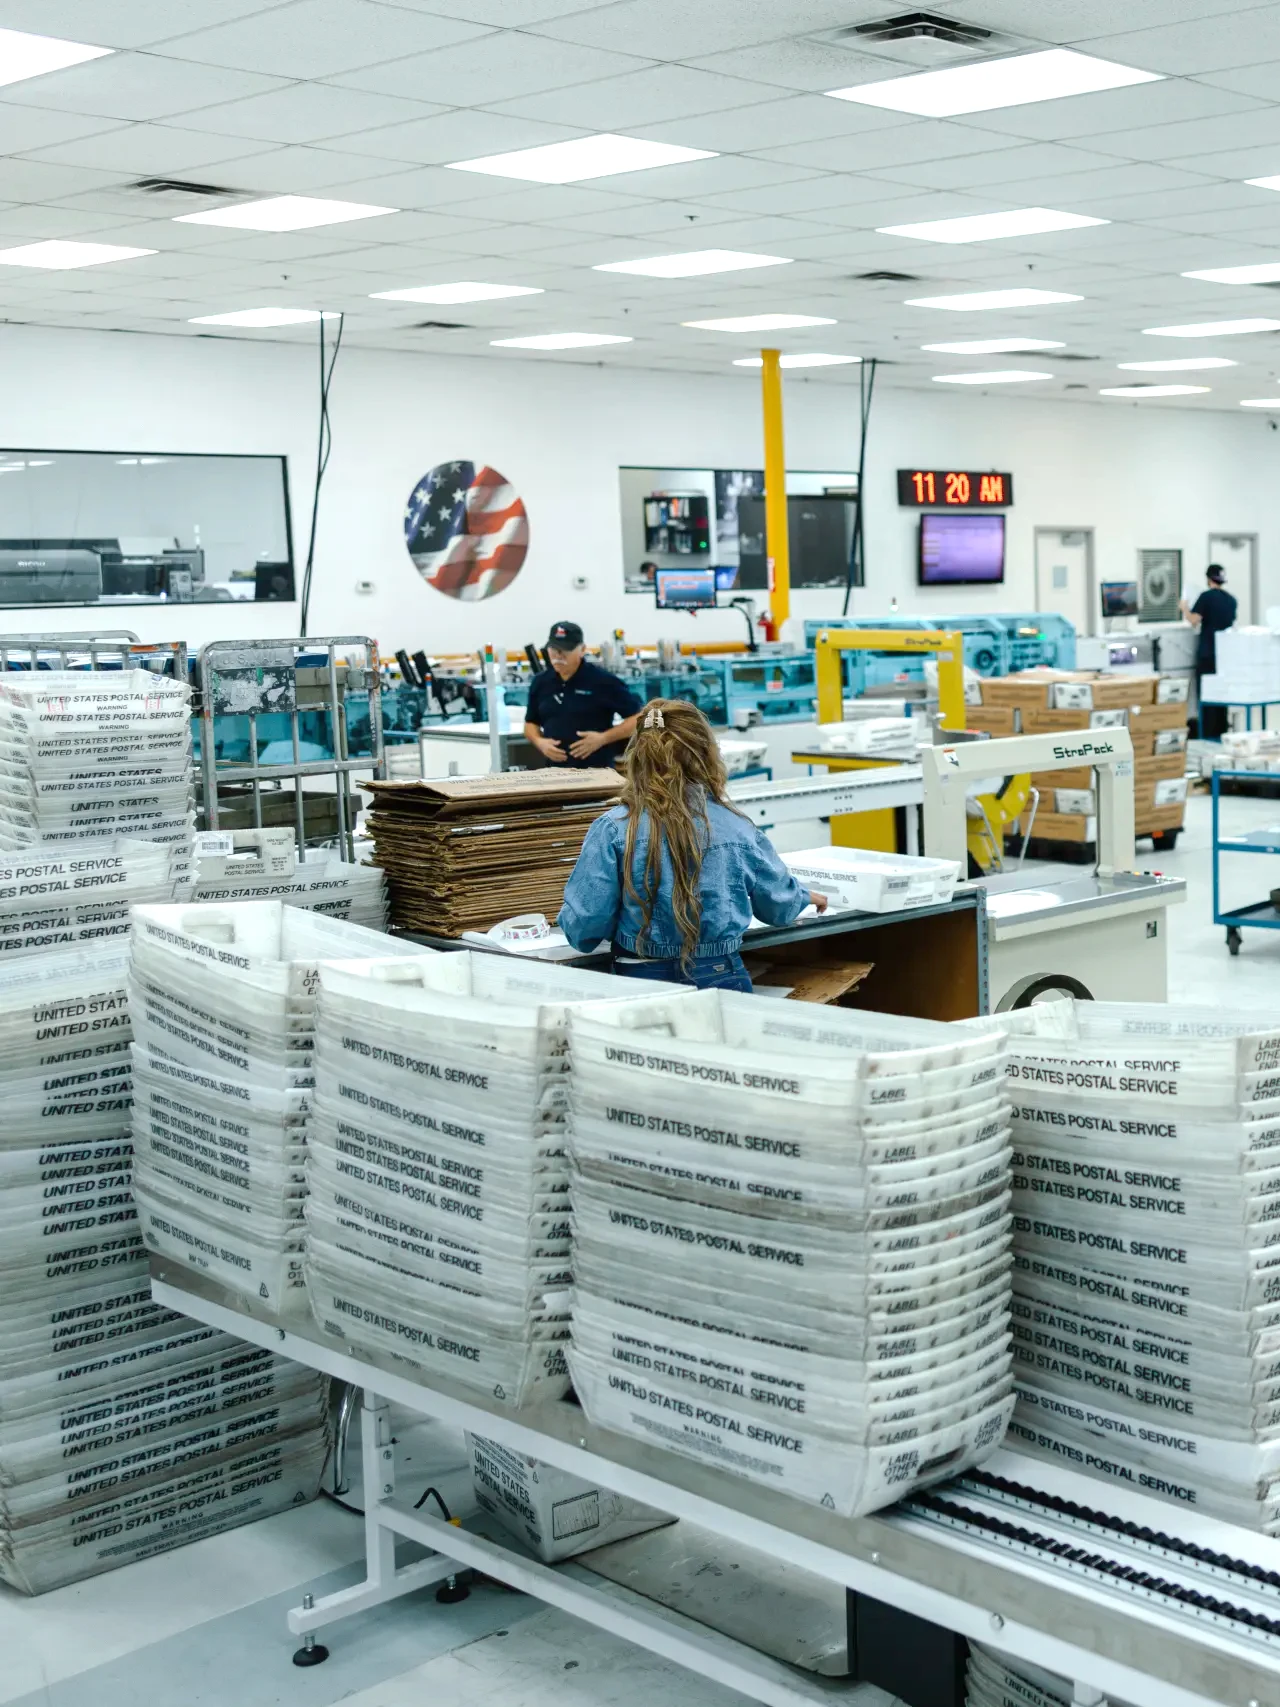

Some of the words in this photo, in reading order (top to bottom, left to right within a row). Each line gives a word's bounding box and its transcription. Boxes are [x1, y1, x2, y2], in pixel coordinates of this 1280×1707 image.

[912, 472, 936, 503] 11
[945, 474, 970, 503] 20
[980, 476, 1003, 502] AM
[73, 695, 109, 703] STATES
[111, 693, 144, 701] POSTAL
[148, 691, 183, 699] SERVICE
[40, 714, 73, 722] UNITED
[76, 713, 110, 721] STATES
[113, 712, 146, 720] POSTAL
[150, 710, 184, 719] SERVICE
[1053, 742, 1113, 758] StraPack
[41, 784, 75, 792] UNITED
[77, 782, 111, 791] STATES
[114, 779, 147, 788] POSTAL
[150, 775, 185, 785] SERVICE
[42, 832, 76, 841] UNITED
[79, 829, 113, 838] STATES
[116, 825, 149, 834] POSTAL
[152, 819, 187, 828] SERVICE
[16, 865, 65, 879] POSTAL
[70, 858, 123, 872] SERVICE
[20, 880, 69, 896] POSTAL
[74, 872, 127, 888] SERVICE
[231, 887, 269, 897] STATES
[270, 883, 306, 894] POSTAL
[310, 880, 349, 891] SERVICE
[313, 899, 353, 912] SERVICE
[26, 933, 76, 947] POSTAL
[79, 923, 132, 940] SERVICE
[145, 924, 167, 940] UNITED
[167, 932, 191, 950] STATES
[191, 942, 217, 960] POSTAL
[218, 949, 250, 969] SERVICE
[34, 1004, 85, 1023] UNITED
[145, 1010, 167, 1030] UNITED
[167, 1023, 190, 1043] STATES
[190, 1035, 216, 1056] POSTAL
[218, 1047, 249, 1070] SERVICE
[342, 1036, 371, 1056] UNITED
[372, 1047, 405, 1068] STATES
[406, 1058, 442, 1079] POSTAL
[445, 1068, 488, 1090] SERVICE
[604, 1047, 644, 1067] UNITED
[647, 1055, 689, 1077] STATES
[692, 1065, 740, 1085] POSTAL
[743, 1073, 800, 1094] SERVICE
[972, 1068, 996, 1082] LABEL
[1023, 1066, 1064, 1085] STATES
[1067, 1073, 1116, 1090] POSTAL
[1120, 1078, 1178, 1095] SERVICE
[870, 1088, 906, 1100] LABEL
[339, 1083, 368, 1105] UNITED
[369, 1096, 401, 1118] STATES
[403, 1109, 439, 1132] POSTAL
[442, 1122, 486, 1146] SERVICE
[1023, 1107, 1066, 1125] STATES
[1068, 1114, 1117, 1132] POSTAL
[1120, 1121, 1177, 1138] SERVICE
[151, 1108, 170, 1125] UNITED
[170, 1115, 193, 1134] STATES
[193, 1125, 219, 1145] POSTAL
[219, 1134, 249, 1155] SERVICE
[606, 1107, 645, 1128] UNITED
[648, 1116, 692, 1137] STATES
[694, 1125, 742, 1148] POSTAL
[744, 1136, 801, 1158] SERVICE
[39, 1149, 91, 1165] UNITED
[885, 1145, 916, 1159] LABEL
[336, 1161, 365, 1180] UNITED
[367, 1172, 400, 1193] STATES
[402, 1184, 438, 1207] POSTAL
[440, 1196, 484, 1221] SERVICE
[887, 1192, 918, 1206] LABEL
[43, 1216, 95, 1236] UNITED
[150, 1216, 171, 1234] UNITED
[171, 1225, 194, 1244] STATES
[194, 1238, 220, 1258] POSTAL
[221, 1247, 252, 1271] SERVICE
[888, 1236, 920, 1250] LABEL
[1034, 1221, 1076, 1243] STATES
[1079, 1231, 1127, 1253] POSTAL
[1130, 1241, 1187, 1263] SERVICE
[333, 1297, 362, 1319] UNITED
[364, 1311, 396, 1332] STATES
[398, 1324, 434, 1347] POSTAL
[437, 1337, 480, 1362] SERVICE
[878, 1366, 913, 1379] LABEL
[61, 1411, 111, 1430] UNITED
[114, 1394, 165, 1416] STATES
[168, 1378, 216, 1400] POSTAL
[221, 1360, 275, 1383] SERVICE
[886, 1386, 919, 1400] LABEL
[609, 1375, 647, 1399] UNITED
[649, 1389, 694, 1417] STATES
[696, 1408, 744, 1436] POSTAL
[746, 1425, 804, 1454] SERVICE
[978, 1414, 1002, 1432] LABEL
[1041, 1396, 1084, 1420] STATES
[1086, 1412, 1137, 1437] POSTAL
[1139, 1428, 1197, 1454] SERVICE
[683, 1424, 723, 1444] WARNING
[974, 1424, 1001, 1443] OTHER
[976, 1435, 993, 1449] END
[888, 1450, 919, 1466] LABEL
[1007, 1422, 1036, 1442] ITED
[1038, 1434, 1083, 1462] STATES
[1085, 1454, 1136, 1483] POSTAL
[1139, 1473, 1197, 1503] SERVICE
[474, 1449, 499, 1478] UNITED
[501, 1472, 530, 1503] STATES
[884, 1460, 918, 1478] OTHER
[887, 1472, 909, 1485] END
[474, 1465, 502, 1496] POSTAL
[504, 1489, 535, 1524] SERVICE
[73, 1526, 122, 1547] UNITED
[125, 1507, 176, 1532] STATES
[179, 1489, 228, 1513] POSTAL
[232, 1470, 283, 1495] SERVICE
[162, 1512, 204, 1530] WARNING
